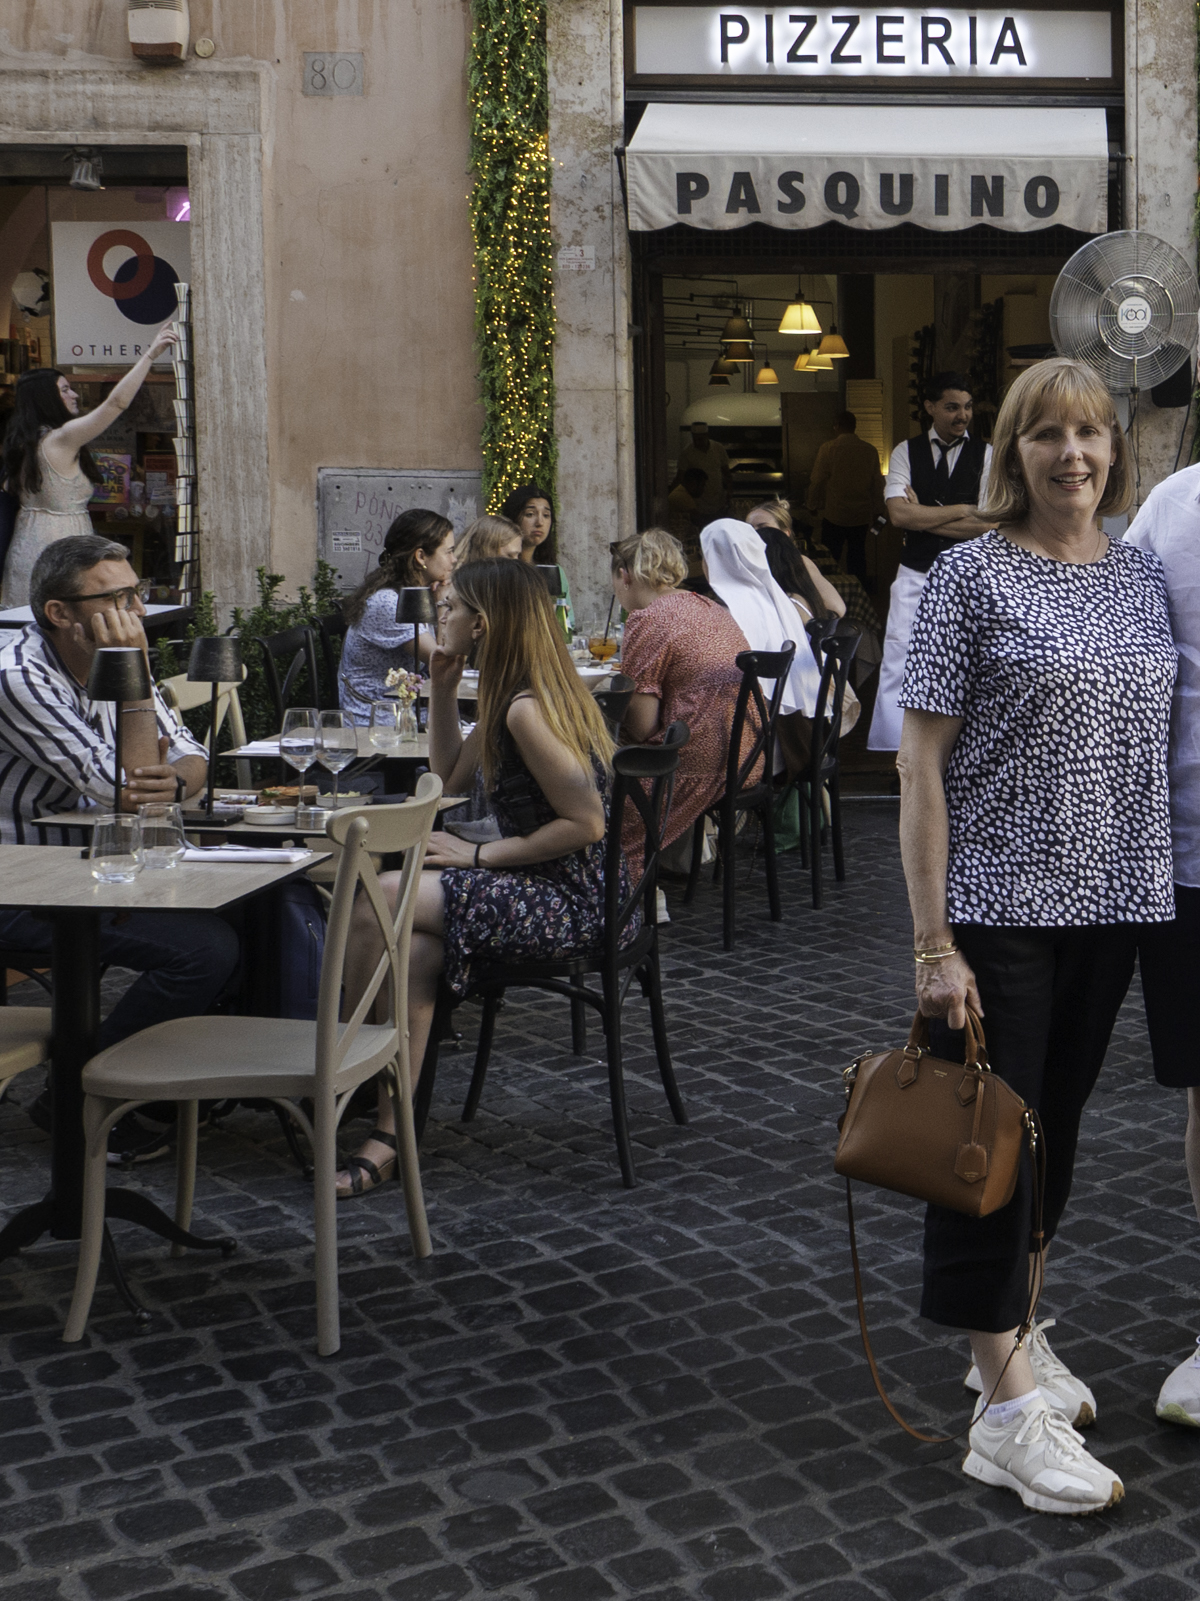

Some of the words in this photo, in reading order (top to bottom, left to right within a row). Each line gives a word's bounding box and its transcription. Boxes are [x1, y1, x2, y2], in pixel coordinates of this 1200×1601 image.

[718, 13, 1028, 66] PIZZERIA
[311, 58, 357, 90] 80
[675, 170, 1061, 221] PASQUINO
